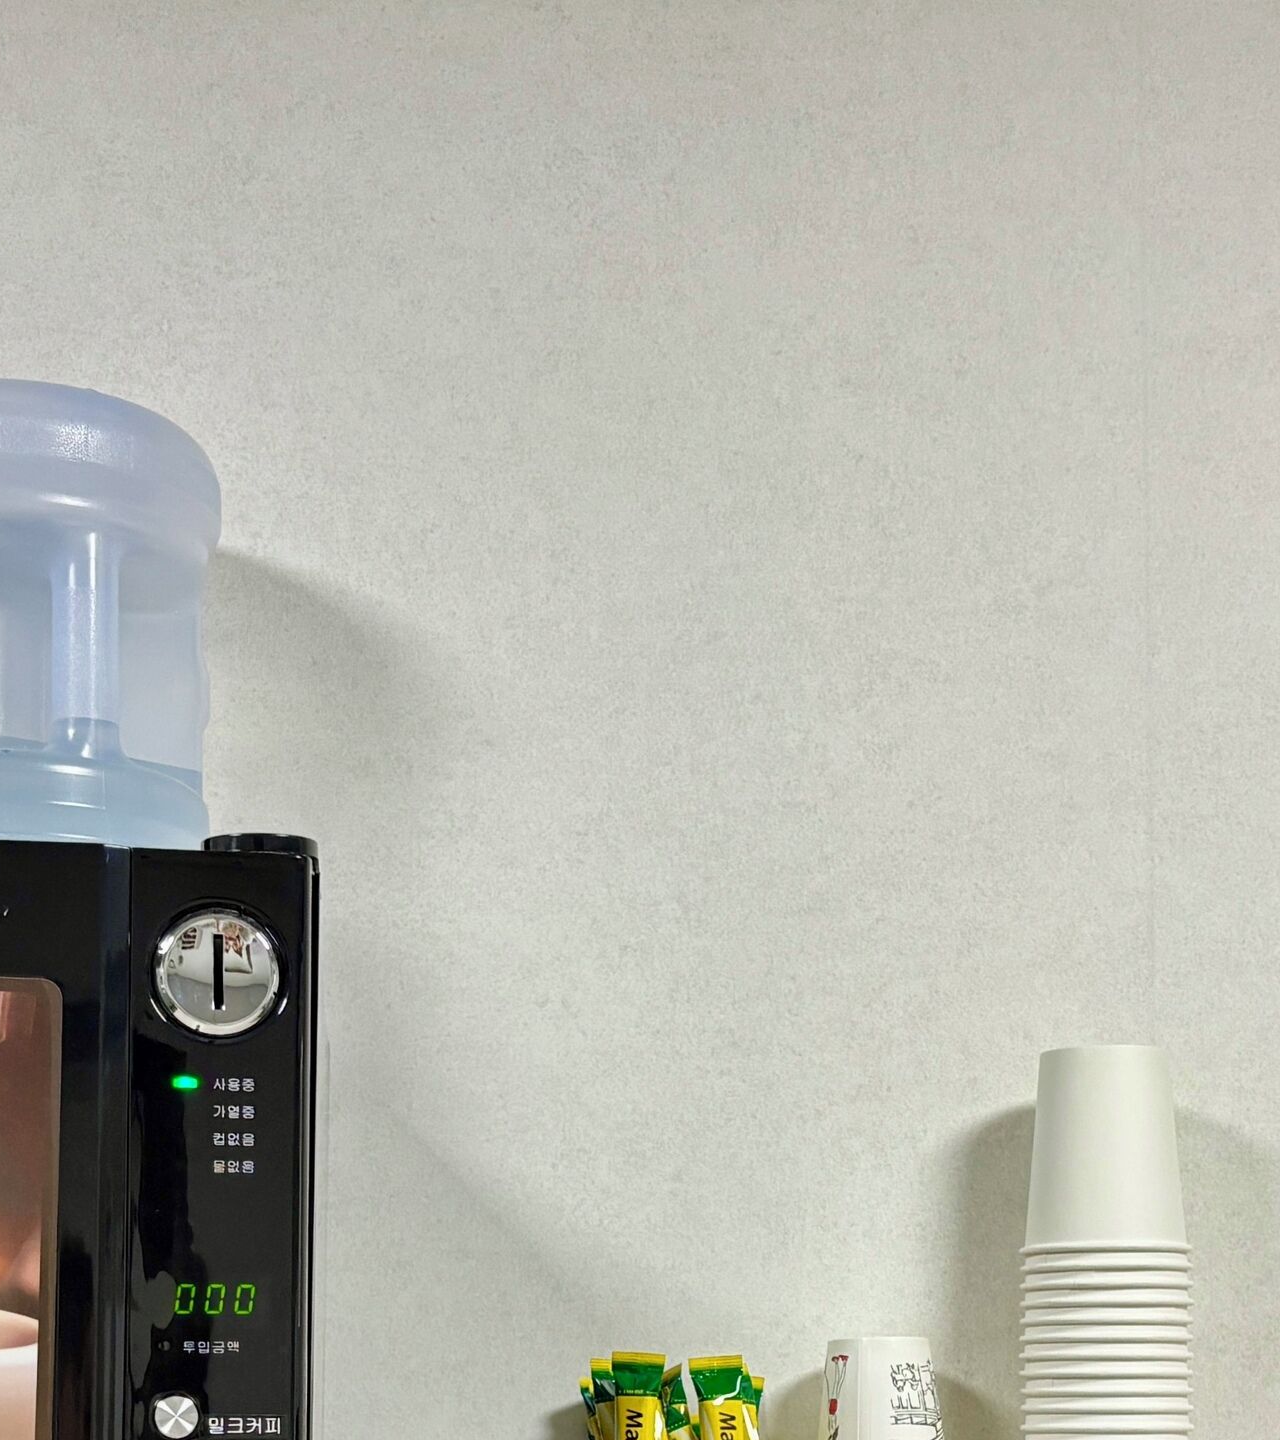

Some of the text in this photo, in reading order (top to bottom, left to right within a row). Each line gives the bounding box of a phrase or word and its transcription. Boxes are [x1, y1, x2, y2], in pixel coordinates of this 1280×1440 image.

[213, 1077, 255, 1092] 사용중
[213, 1104, 255, 1119] 가열중
[213, 1132, 255, 1147] 컵없음
[174, 1283, 257, 1316] 000
[208, 1417, 281, 1435] 밀크커피
